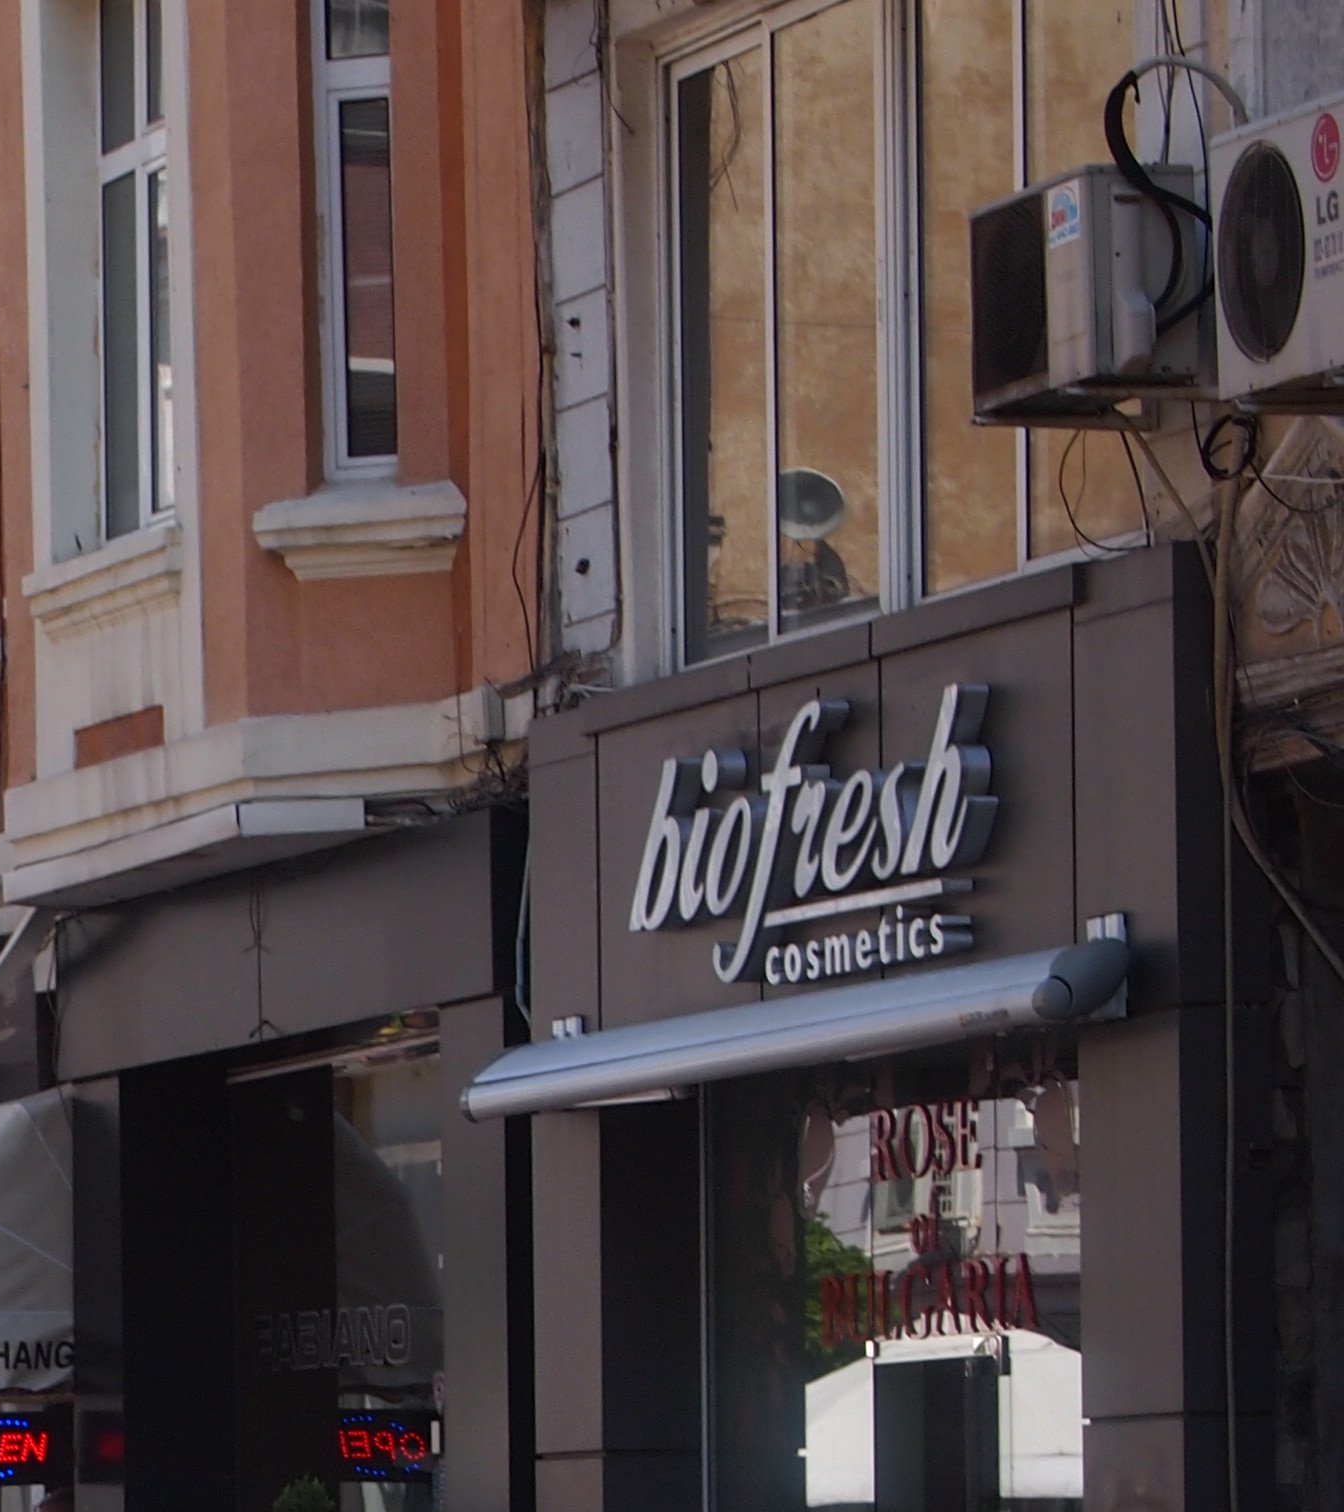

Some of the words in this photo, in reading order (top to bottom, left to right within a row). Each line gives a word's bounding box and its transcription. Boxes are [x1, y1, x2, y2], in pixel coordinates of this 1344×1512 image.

[1316, 190, 1340, 226] LG
[629, 683, 970, 983] biofresh
[765, 904, 945, 986] cosmetics
[870, 1098, 983, 1181] ROSE
[909, 1185, 942, 1256] of
[820, 1253, 1040, 1346] BULGARIA
